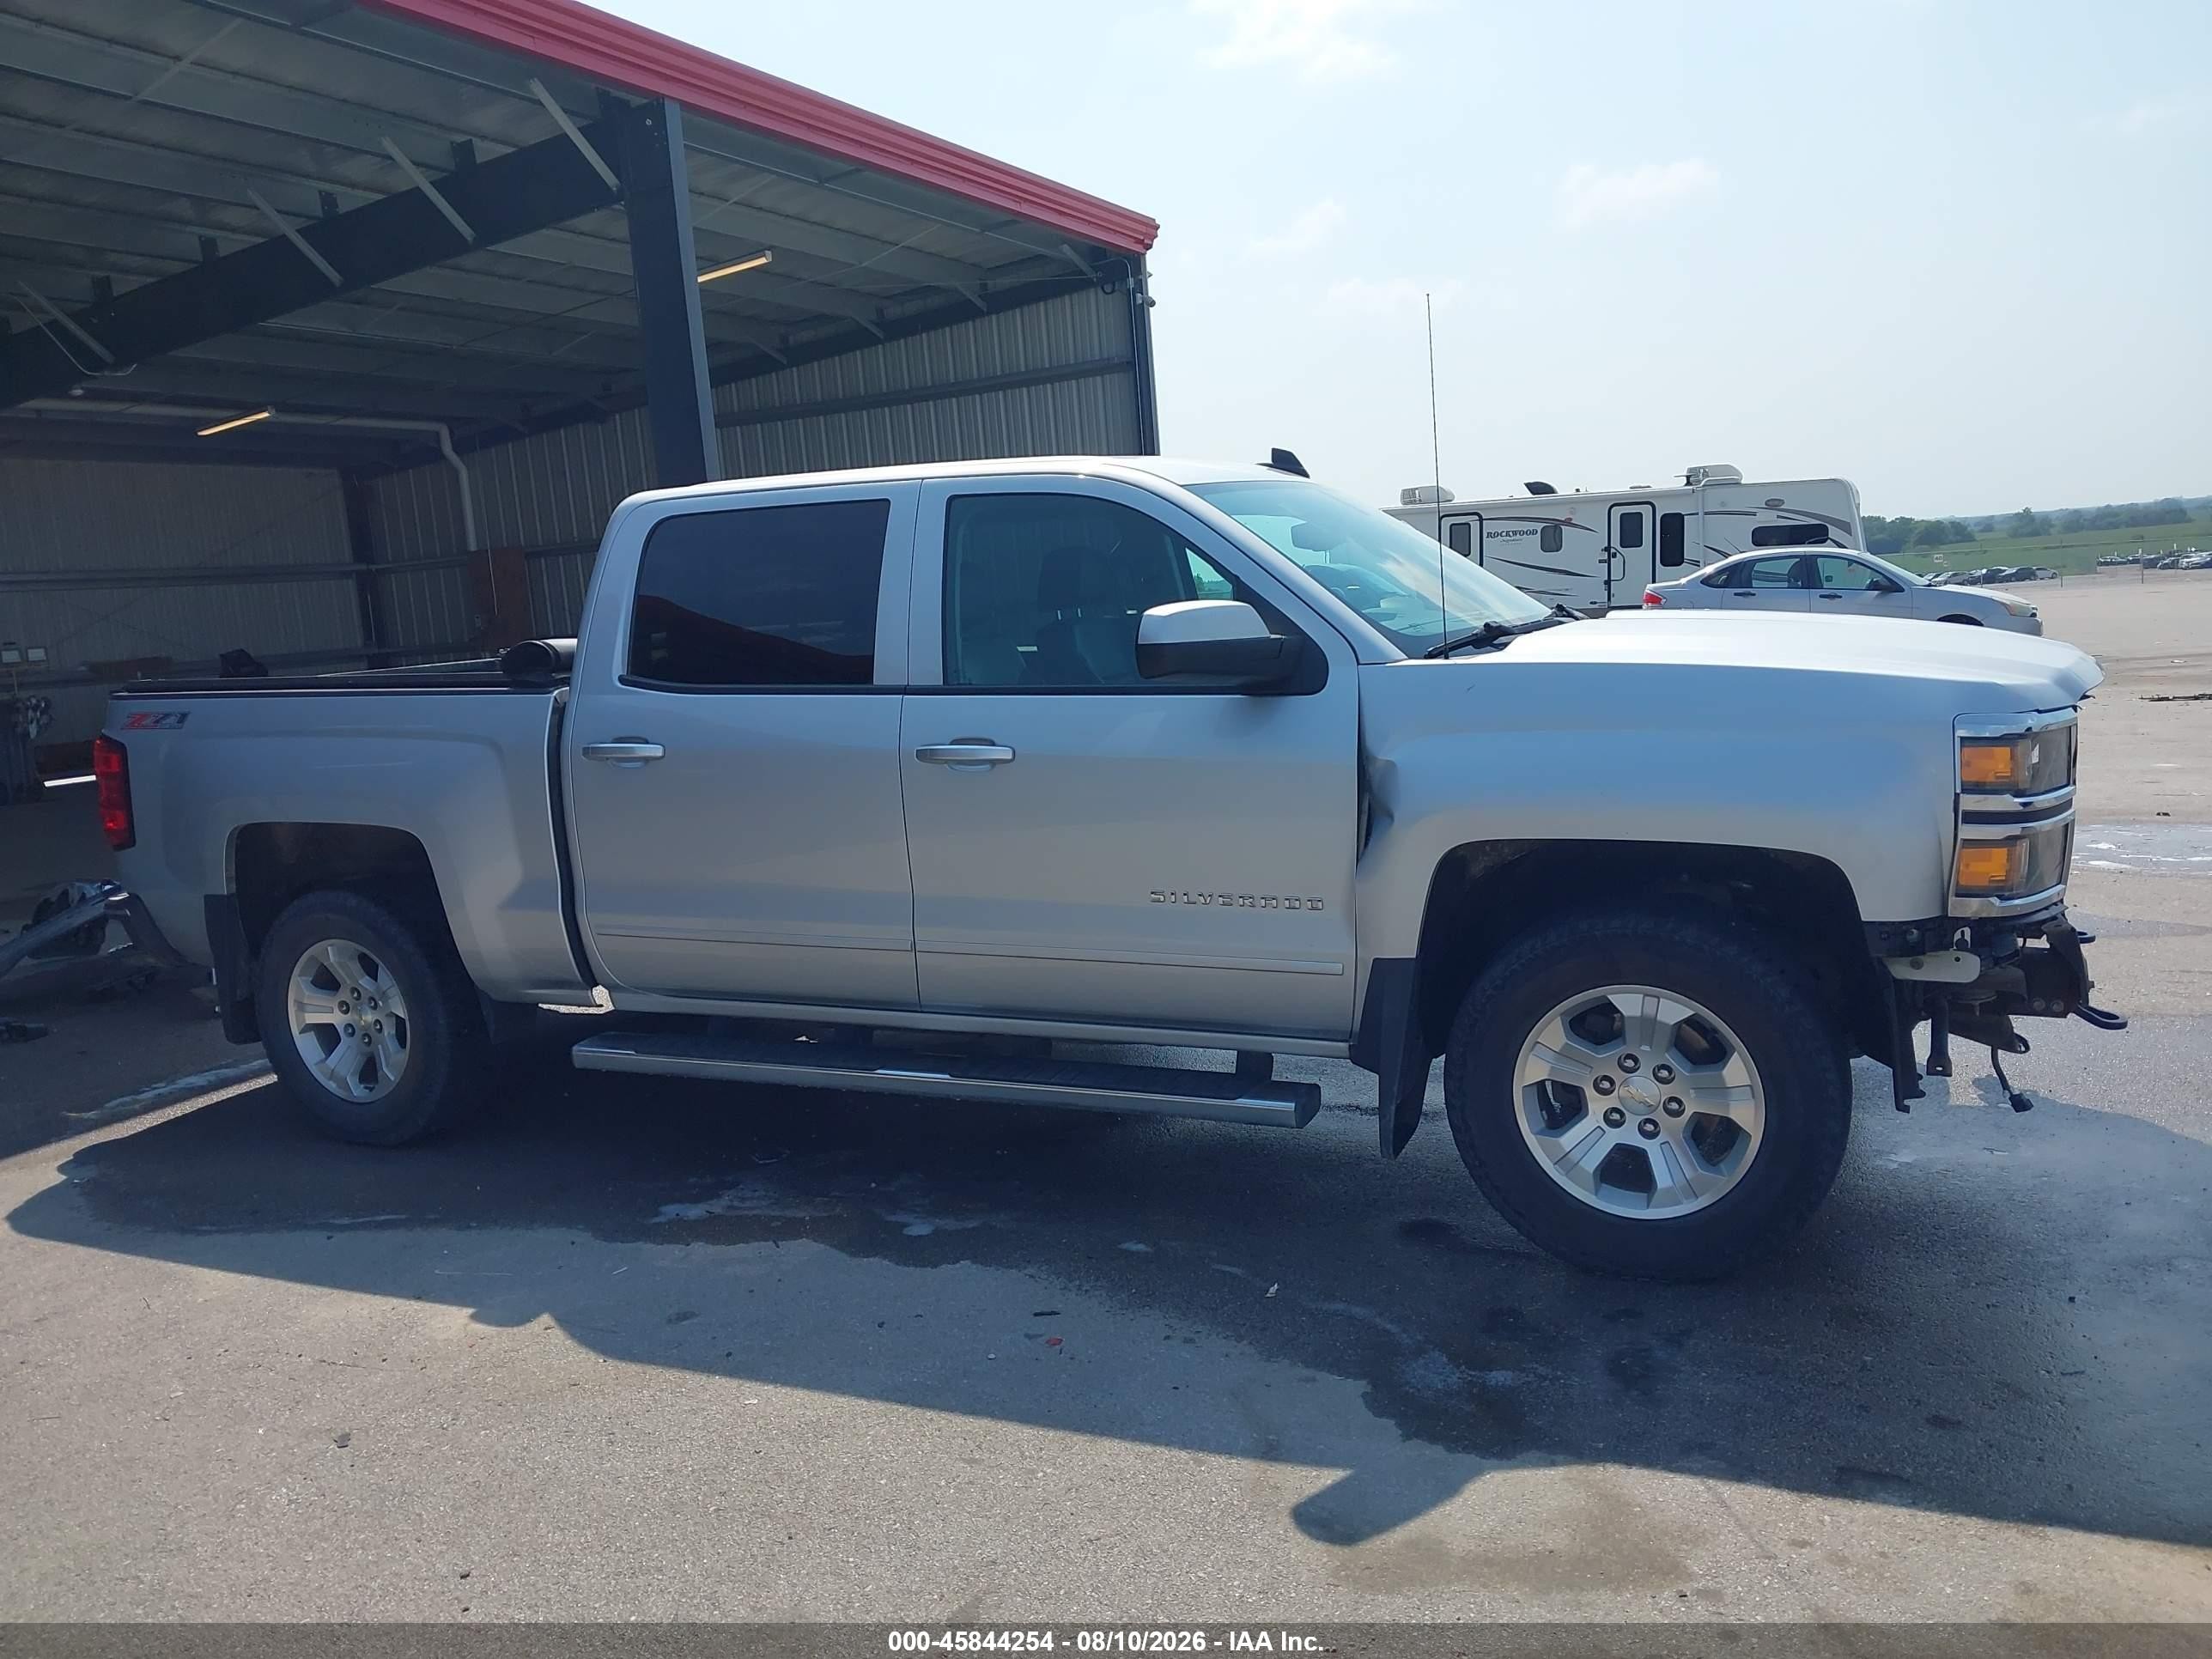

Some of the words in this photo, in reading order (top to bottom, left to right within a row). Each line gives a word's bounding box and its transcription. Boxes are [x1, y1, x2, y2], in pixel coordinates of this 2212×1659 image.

[1486, 529, 1538, 538] ROCKWOOD
[122, 712, 191, 729] Z71
[1150, 890, 1324, 911] SILVERADO
